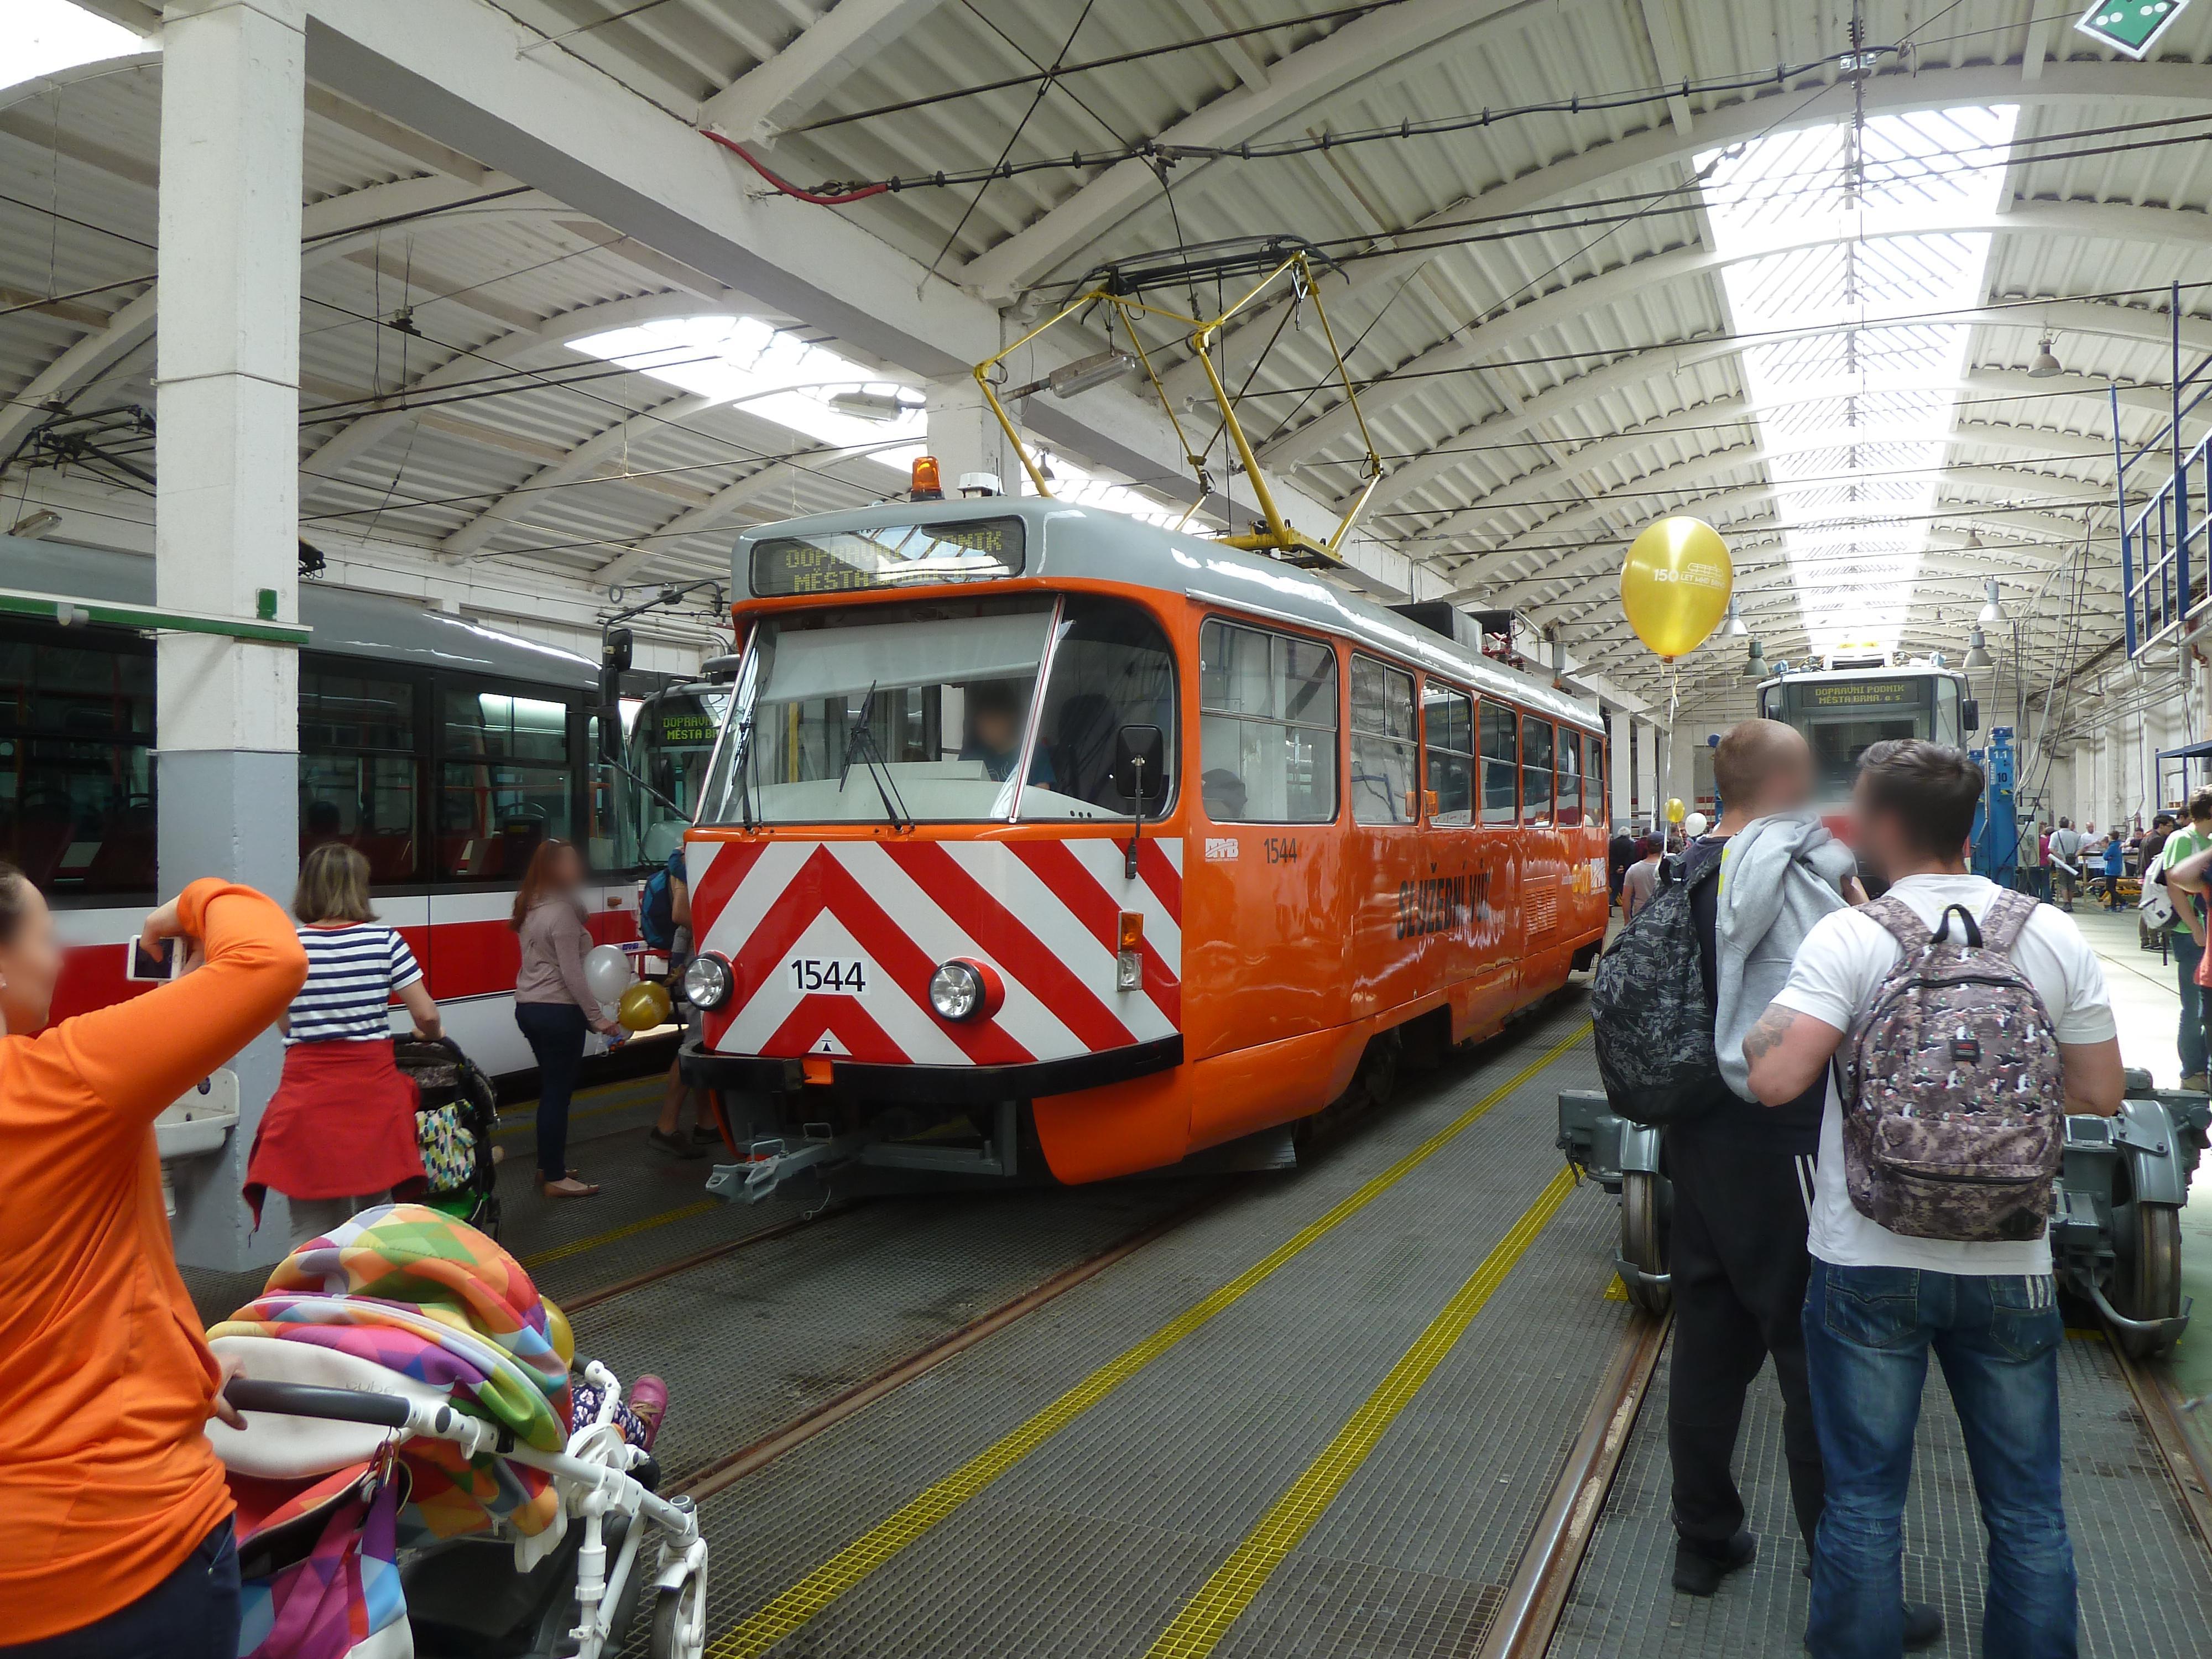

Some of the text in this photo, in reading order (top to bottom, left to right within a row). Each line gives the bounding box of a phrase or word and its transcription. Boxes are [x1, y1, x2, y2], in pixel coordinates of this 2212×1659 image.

[1654, 568, 1679, 583] 150
[1867, 685, 1905, 693] PODNIK
[1997, 772, 2007, 782] 10
[1264, 838, 1297, 864] 1544
[791, 959, 866, 992] 1544
